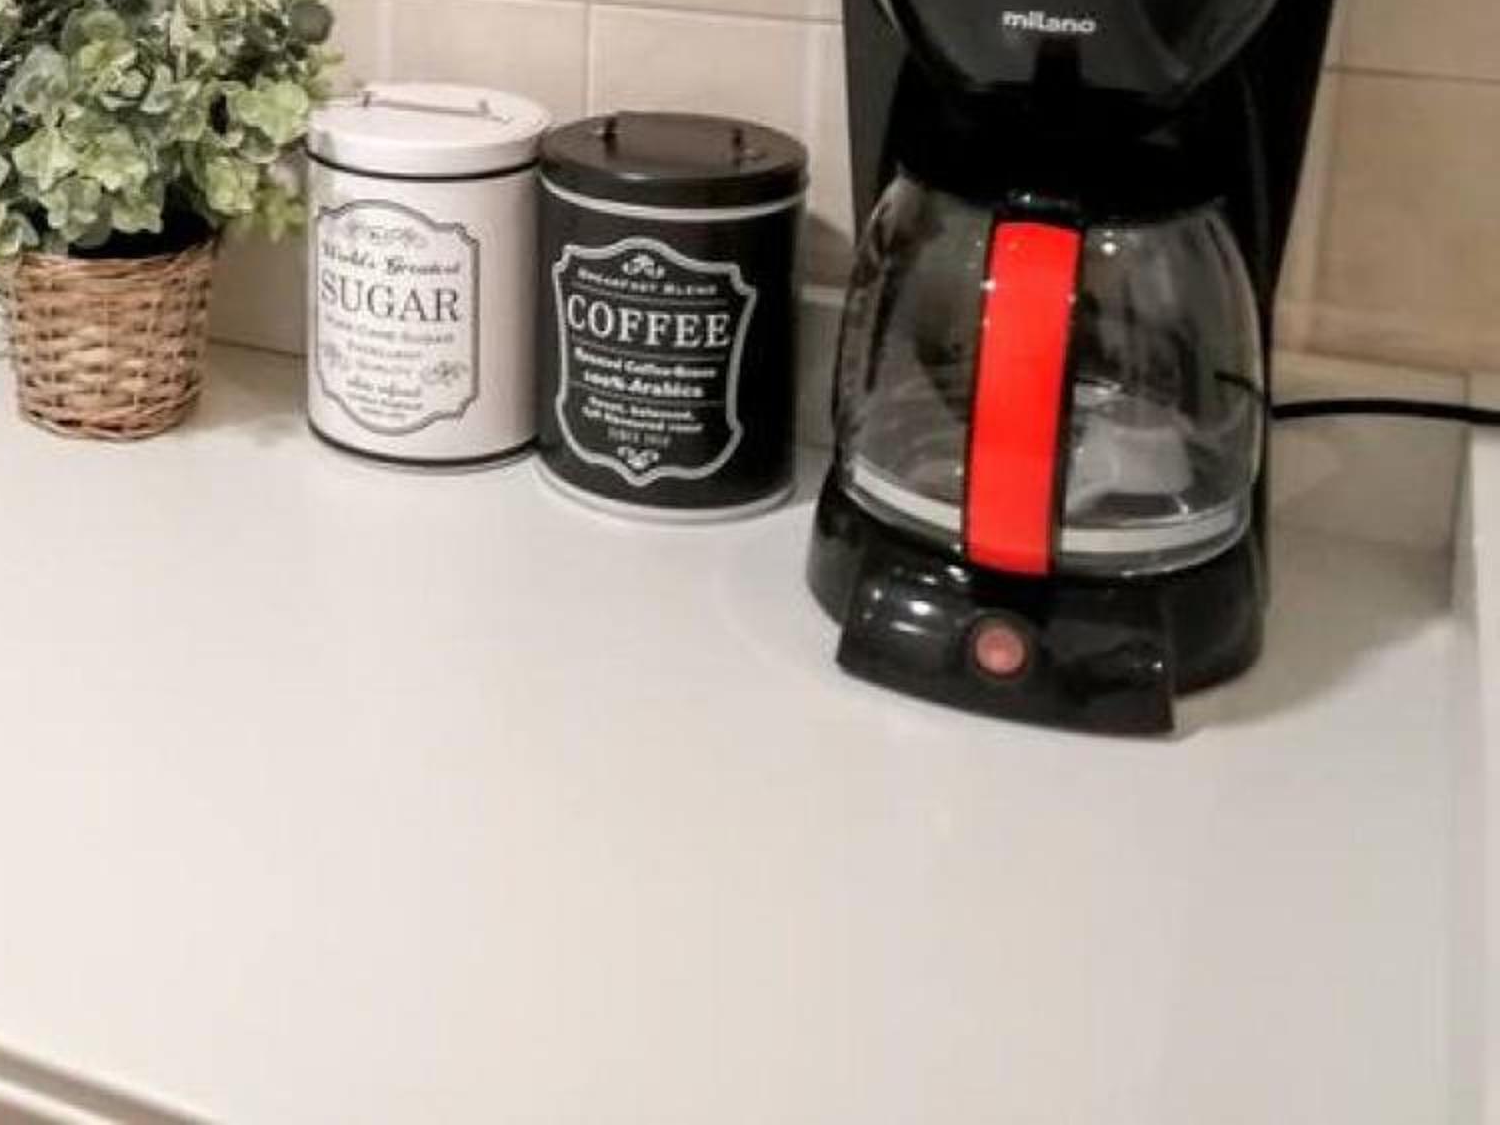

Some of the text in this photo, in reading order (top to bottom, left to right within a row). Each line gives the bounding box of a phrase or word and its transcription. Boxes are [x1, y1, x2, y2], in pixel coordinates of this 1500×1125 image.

[1002, 11, 1097, 34] milano
[320, 268, 460, 322] SUGAR
[567, 294, 731, 348] COFFEE
